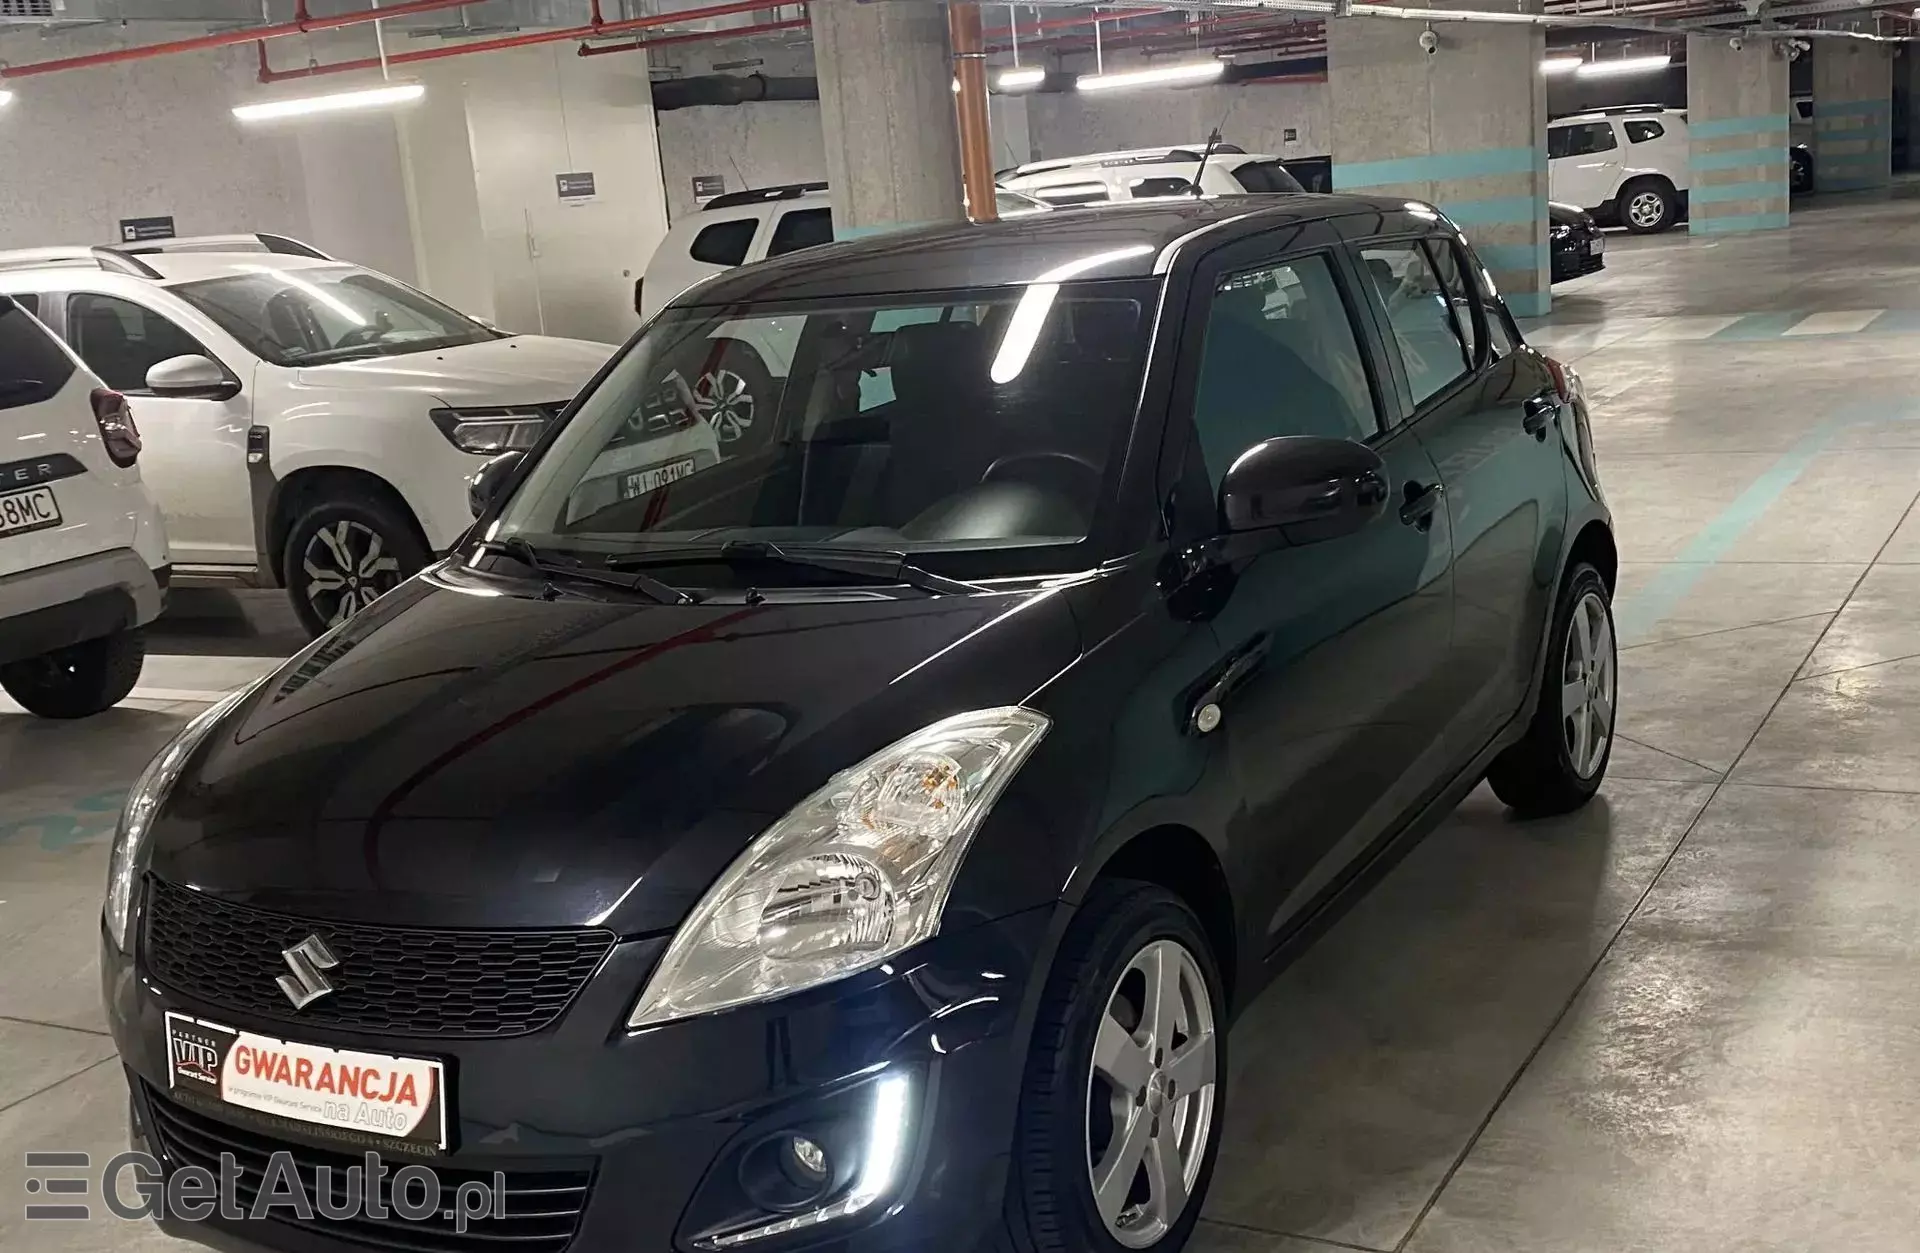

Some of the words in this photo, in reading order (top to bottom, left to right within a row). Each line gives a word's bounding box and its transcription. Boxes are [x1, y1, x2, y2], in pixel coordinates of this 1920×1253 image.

[0, 463, 52, 480] ER
[173, 1037, 217, 1073] VIP
[235, 1045, 418, 1107] GWARANCJA
[324, 1100, 349, 1121] na
[354, 1103, 407, 1130] Auto
